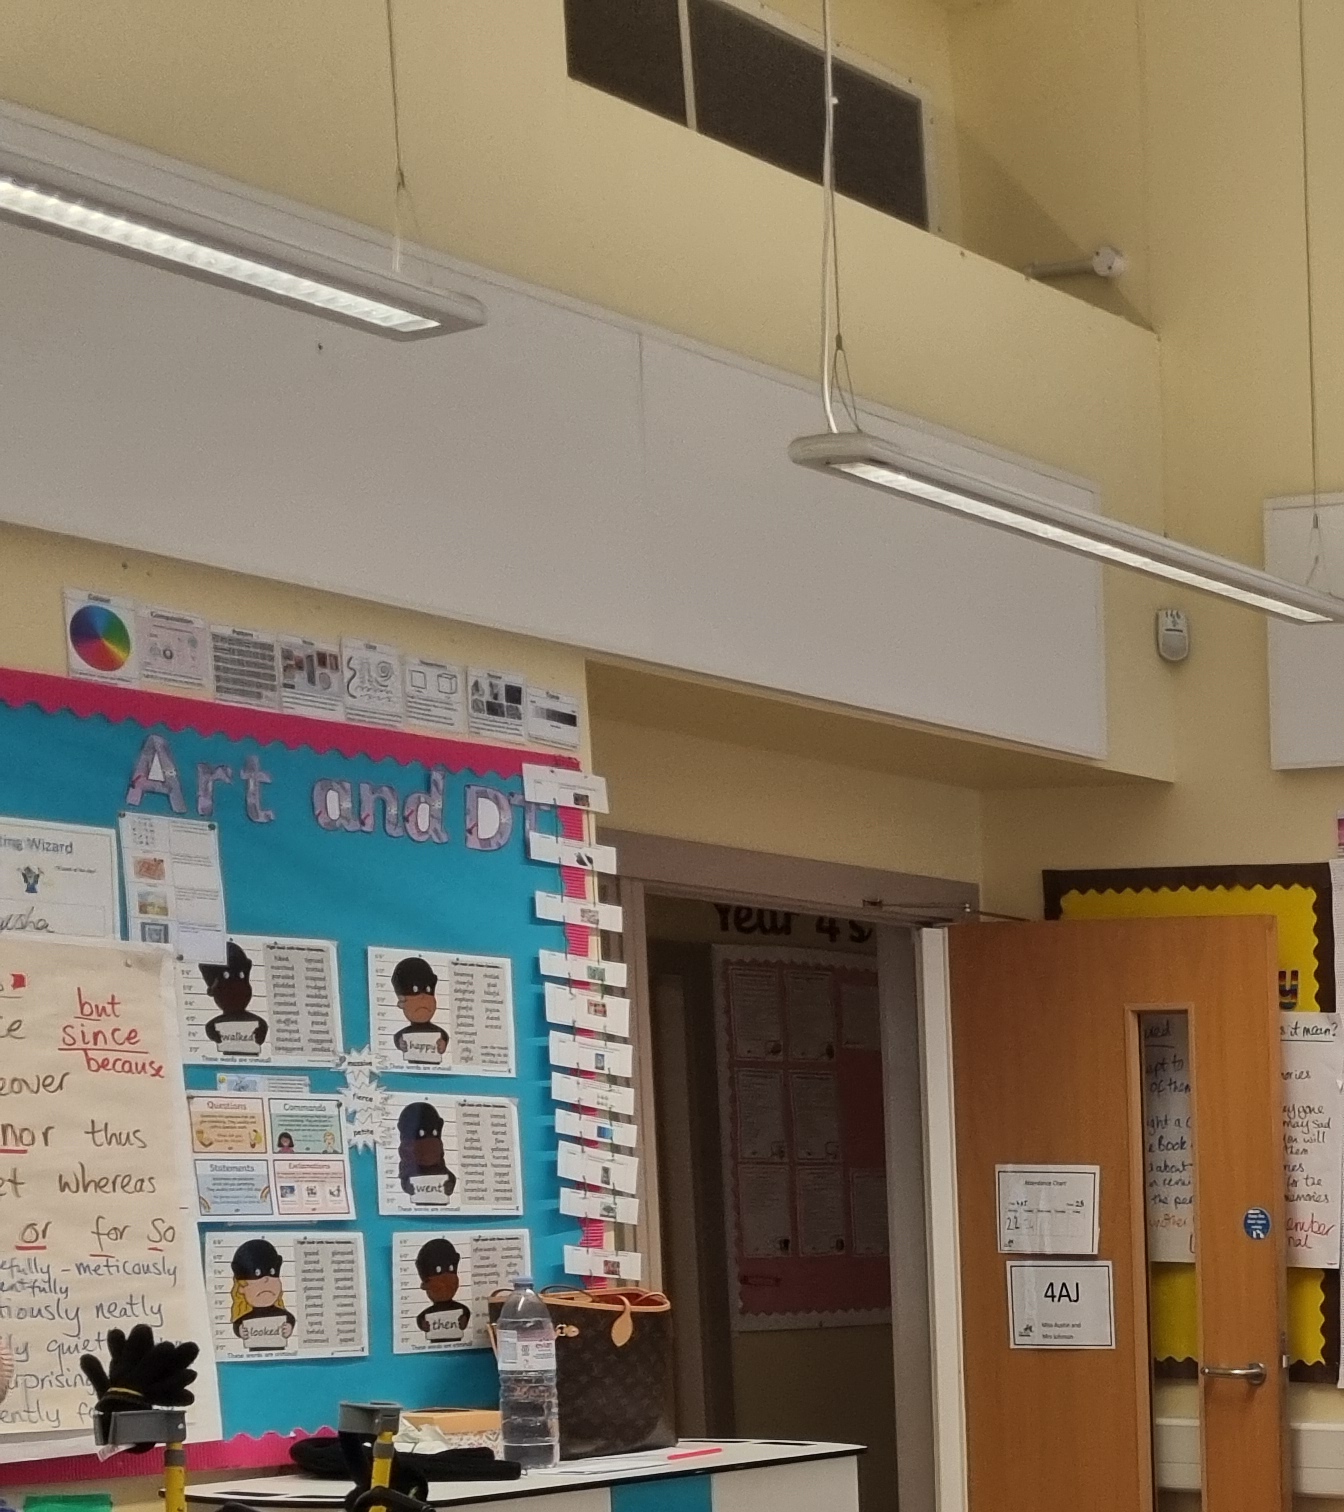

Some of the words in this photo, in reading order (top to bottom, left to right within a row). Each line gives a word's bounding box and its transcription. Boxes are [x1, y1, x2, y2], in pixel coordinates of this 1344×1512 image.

[127, 734, 276, 824] Art
[312, 769, 448, 844] and
[77, 987, 121, 1018] but
[62, 1024, 140, 1047] since
[222, 1031, 256, 1042] walked
[1290, 1021, 1300, 1037] it
[1302, 1022, 1339, 1037] mean?
[409, 1040, 437, 1054] happy
[84, 1049, 165, 1078] because
[207, 1100, 247, 1111] Questions
[1, 1123, 55, 1148] nor
[84, 1119, 147, 1149] thus
[1303, 1131, 1326, 1144] will
[209, 1163, 255, 1173] Statements
[58, 1161, 156, 1195] whereas
[416, 1183, 443, 1194] went
[21, 1221, 52, 1244] or
[91, 1216, 130, 1251] for
[1043, 1281, 1080, 1303] 4AJ
[95, 1294, 164, 1327] neatly
[250, 1325, 281, 1337] looked
[432, 1318, 458, 1331] then
